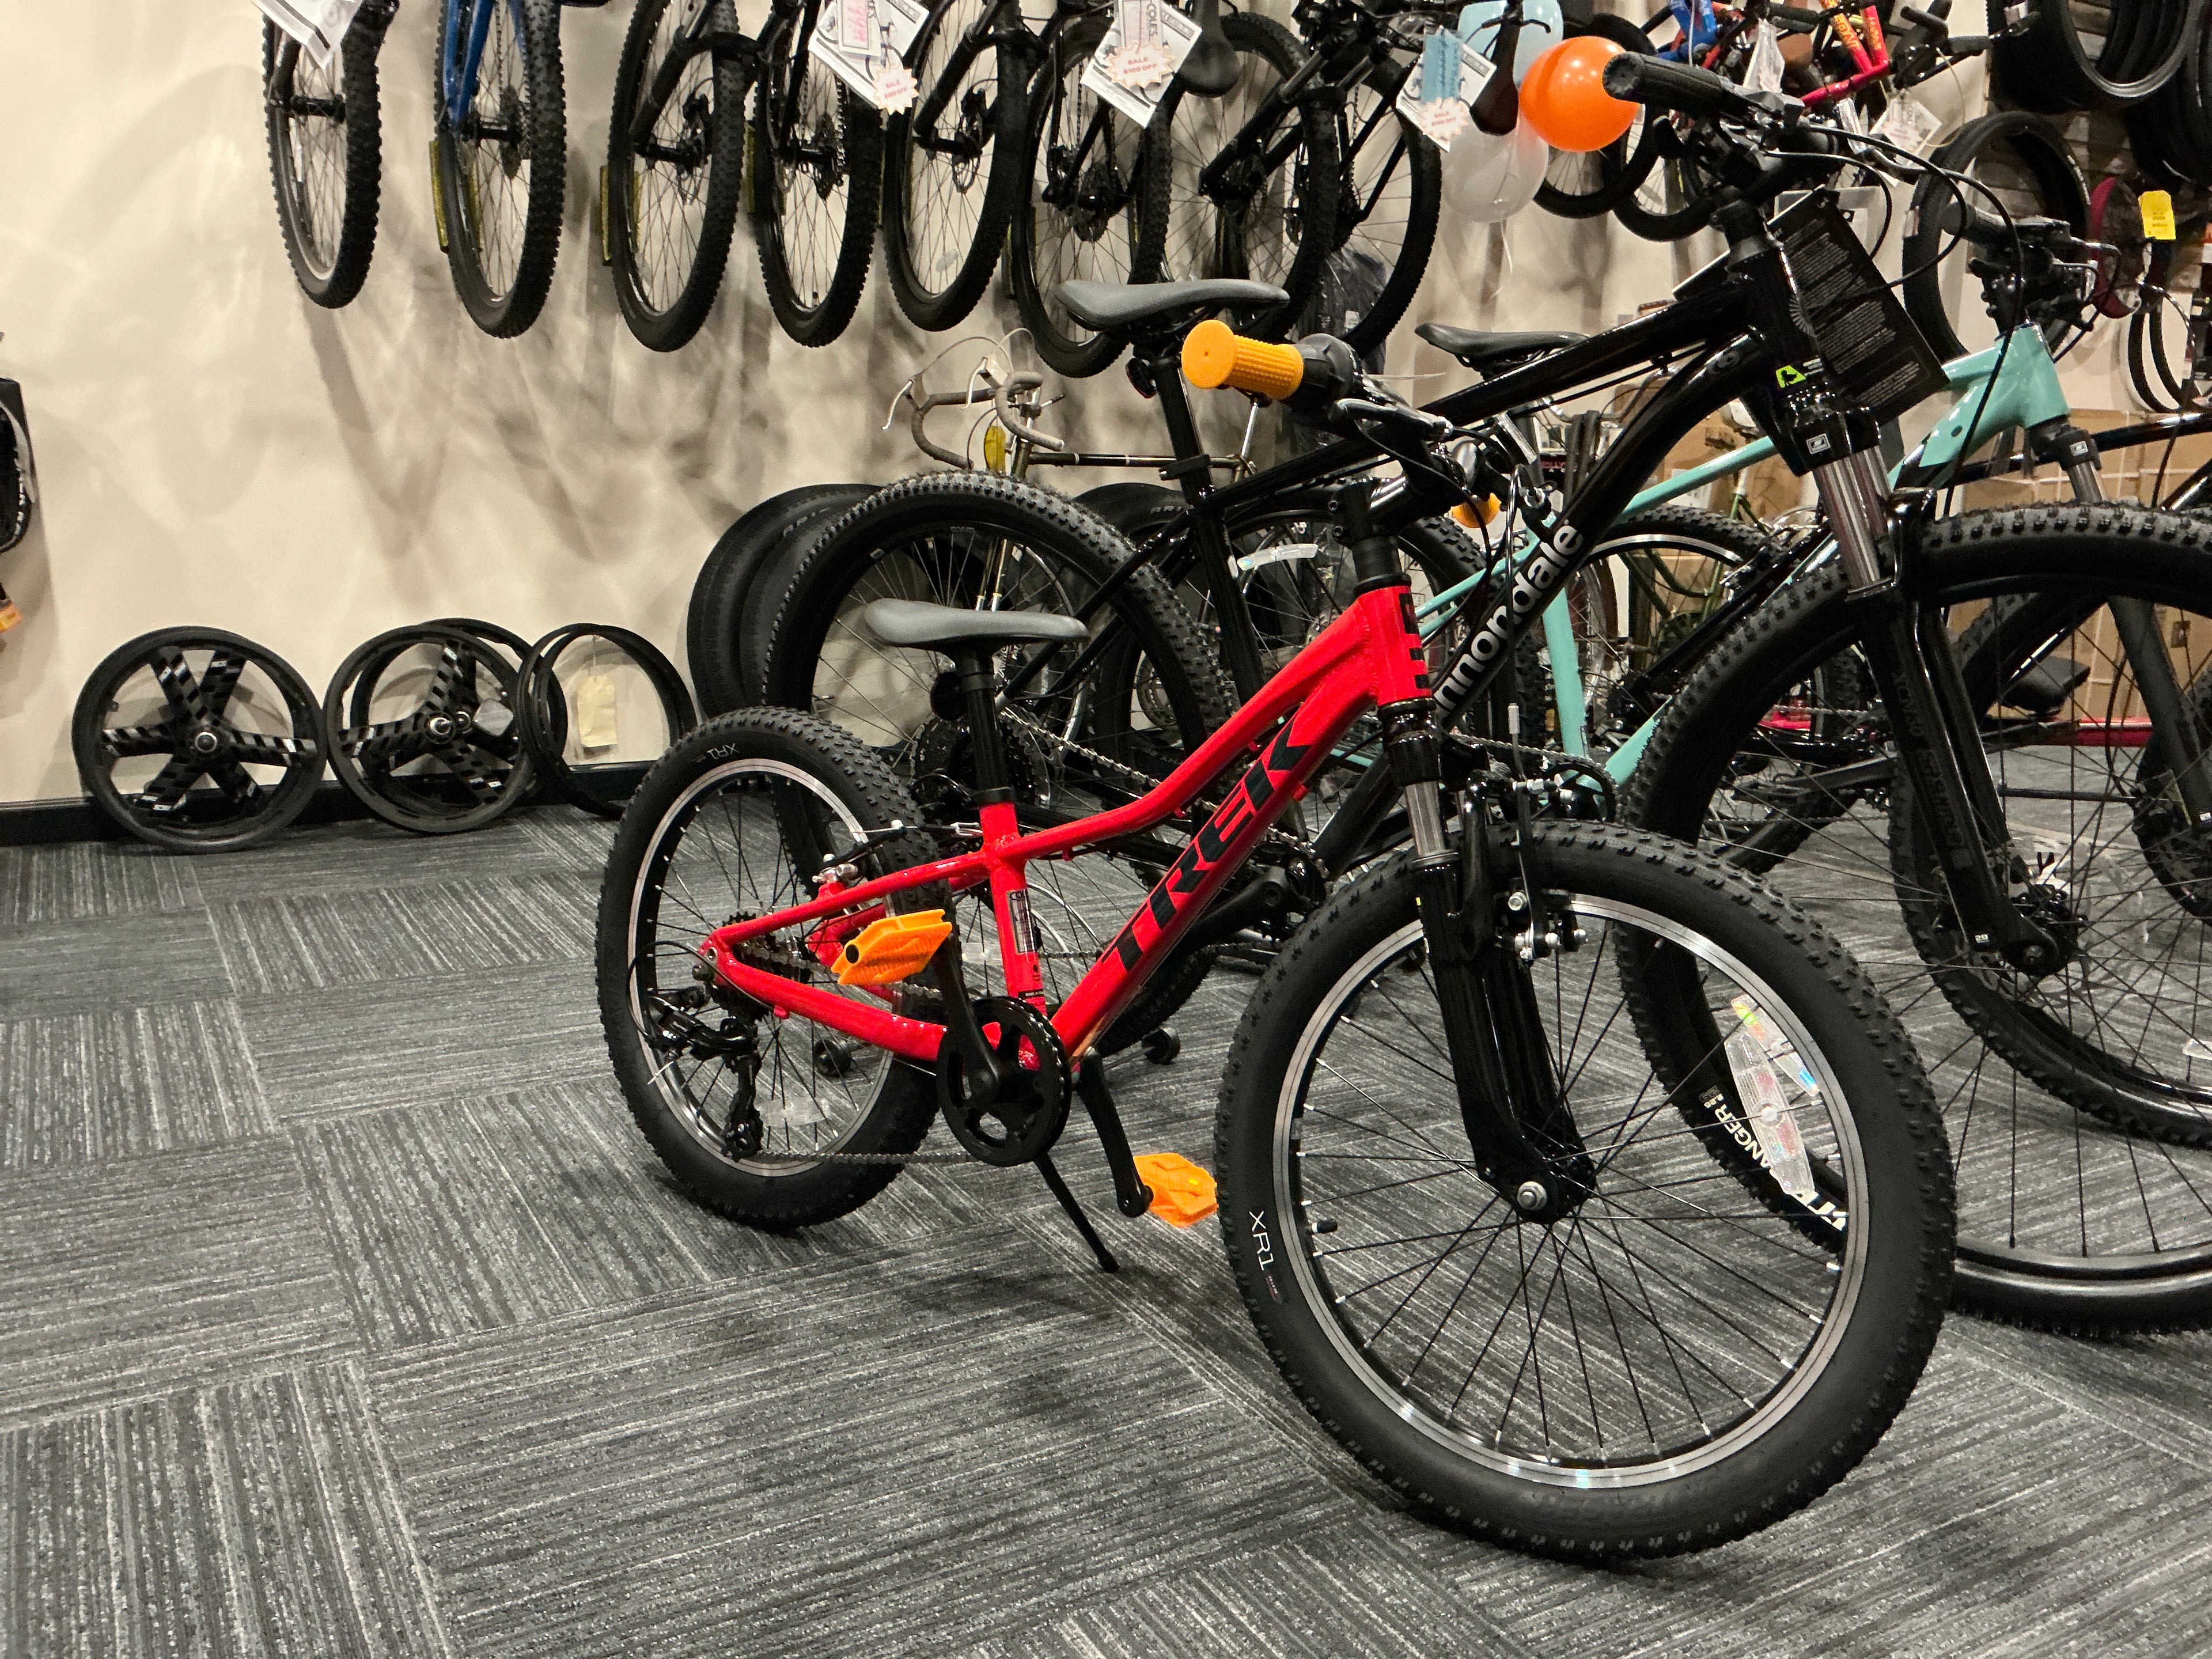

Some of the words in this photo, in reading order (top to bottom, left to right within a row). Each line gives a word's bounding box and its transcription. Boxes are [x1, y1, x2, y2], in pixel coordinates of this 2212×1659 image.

[1146, 3, 1158, 36] COLES
[1123, 66, 1141, 74] $100
[1128, 57, 1149, 65] SALE
[885, 79, 900, 88] SALE
[1435, 525, 1584, 718] nnondale
[706, 743, 740, 760] XR1
[1101, 711, 1312, 971] TREK
[1704, 1093, 1724, 1108] 2.25
[1714, 1104, 1781, 1182] ANGER
[1249, 1210, 1274, 1271] XR1
